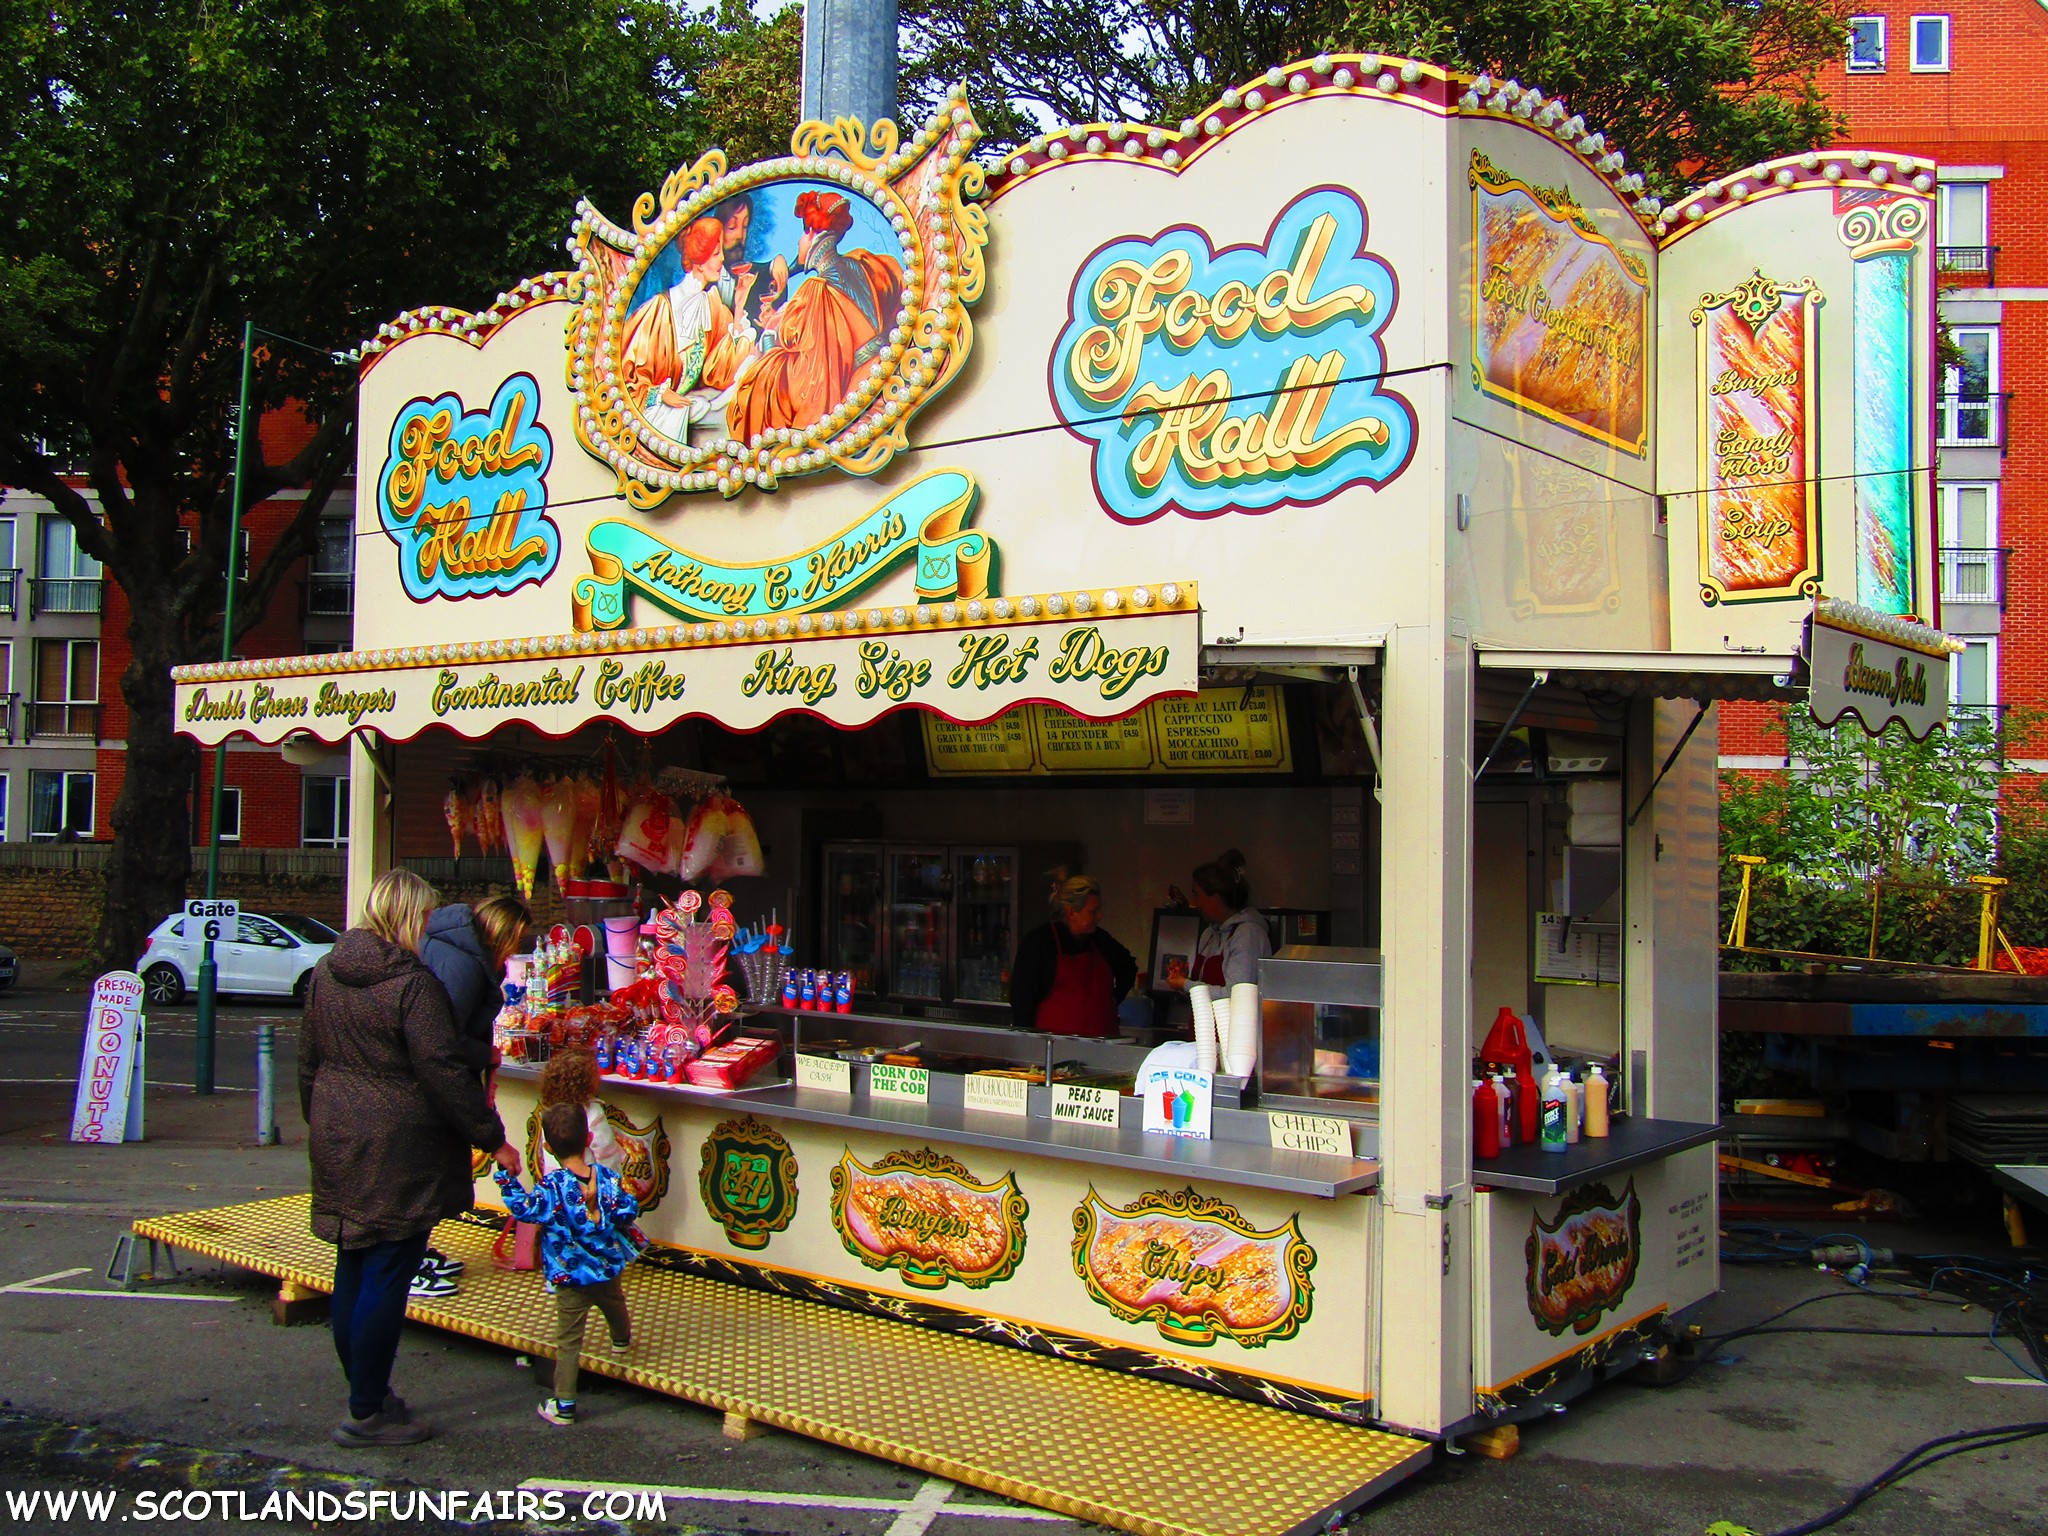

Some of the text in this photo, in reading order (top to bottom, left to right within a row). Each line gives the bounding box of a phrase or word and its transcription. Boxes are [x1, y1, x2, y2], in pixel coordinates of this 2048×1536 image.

[1067, 211, 1376, 413] Food
[1480, 263, 1528, 312] Food
[1531, 279, 1594, 346] Glorious
[1709, 367, 1799, 398] Burgers
[1115, 349, 1390, 498] Hall
[1715, 428, 1795, 457] Candy
[384, 390, 542, 523] Food
[1720, 455, 1789, 479] Floss
[411, 488, 548, 584] Hall
[1721, 509, 1791, 547] Soup
[632, 509, 907, 613] Anthony C. Harris
[741, 626, 1171, 706] King Size Hot Dogs
[1843, 642, 1892, 699] Bacon
[431, 658, 686, 716] Continental Coffee
[184, 681, 397, 725] Double Cheese Burgers
[1163, 703, 1190, 713] CAFE
[1194, 702, 1208, 712] AU
[1213, 701, 1238, 712] LAIT
[1164, 713, 1268, 725] CAPPUCCINO £3.00
[936, 733, 964, 743] GRAVY
[966, 733, 973, 742] &
[975, 733, 1000, 742] CHIPS
[1061, 729, 1109, 739] POUNDER
[1166, 726, 1220, 737] ESPRESSO
[1047, 741, 1082, 751] CHICKEN
[1168, 737, 1239, 748] MOCCACHINO
[1169, 750, 1189, 760] HOT
[1191, 749, 1250, 760] CHOCOLATE
[188, 900, 236, 917] Gate
[1541, 915, 1555, 924] 14
[204, 920, 220, 941] 6
[97, 979, 145, 996] FRESHLY
[98, 994, 132, 1006] MADE
[797, 1056, 847, 1073] WE ACCEPT
[871, 1065, 928, 1082] CORN ON
[82, 1008, 124, 1143] DONUTS
[809, 1071, 832, 1082] CASH
[1149, 1071, 1208, 1089] ICE COLD
[872, 1078, 926, 1095] THE COB
[967, 1076, 1025, 1100] HOT CHOCOLATE
[1068, 1087, 1102, 1104] PEAS &
[1054, 1103, 1115, 1123] MINT SAUCE
[1271, 1114, 1345, 1136] CHEESY
[1282, 1132, 1339, 1154] CHIPS
[877, 1196, 970, 1243] Burgers
[1141, 1238, 1225, 1295] Chips
